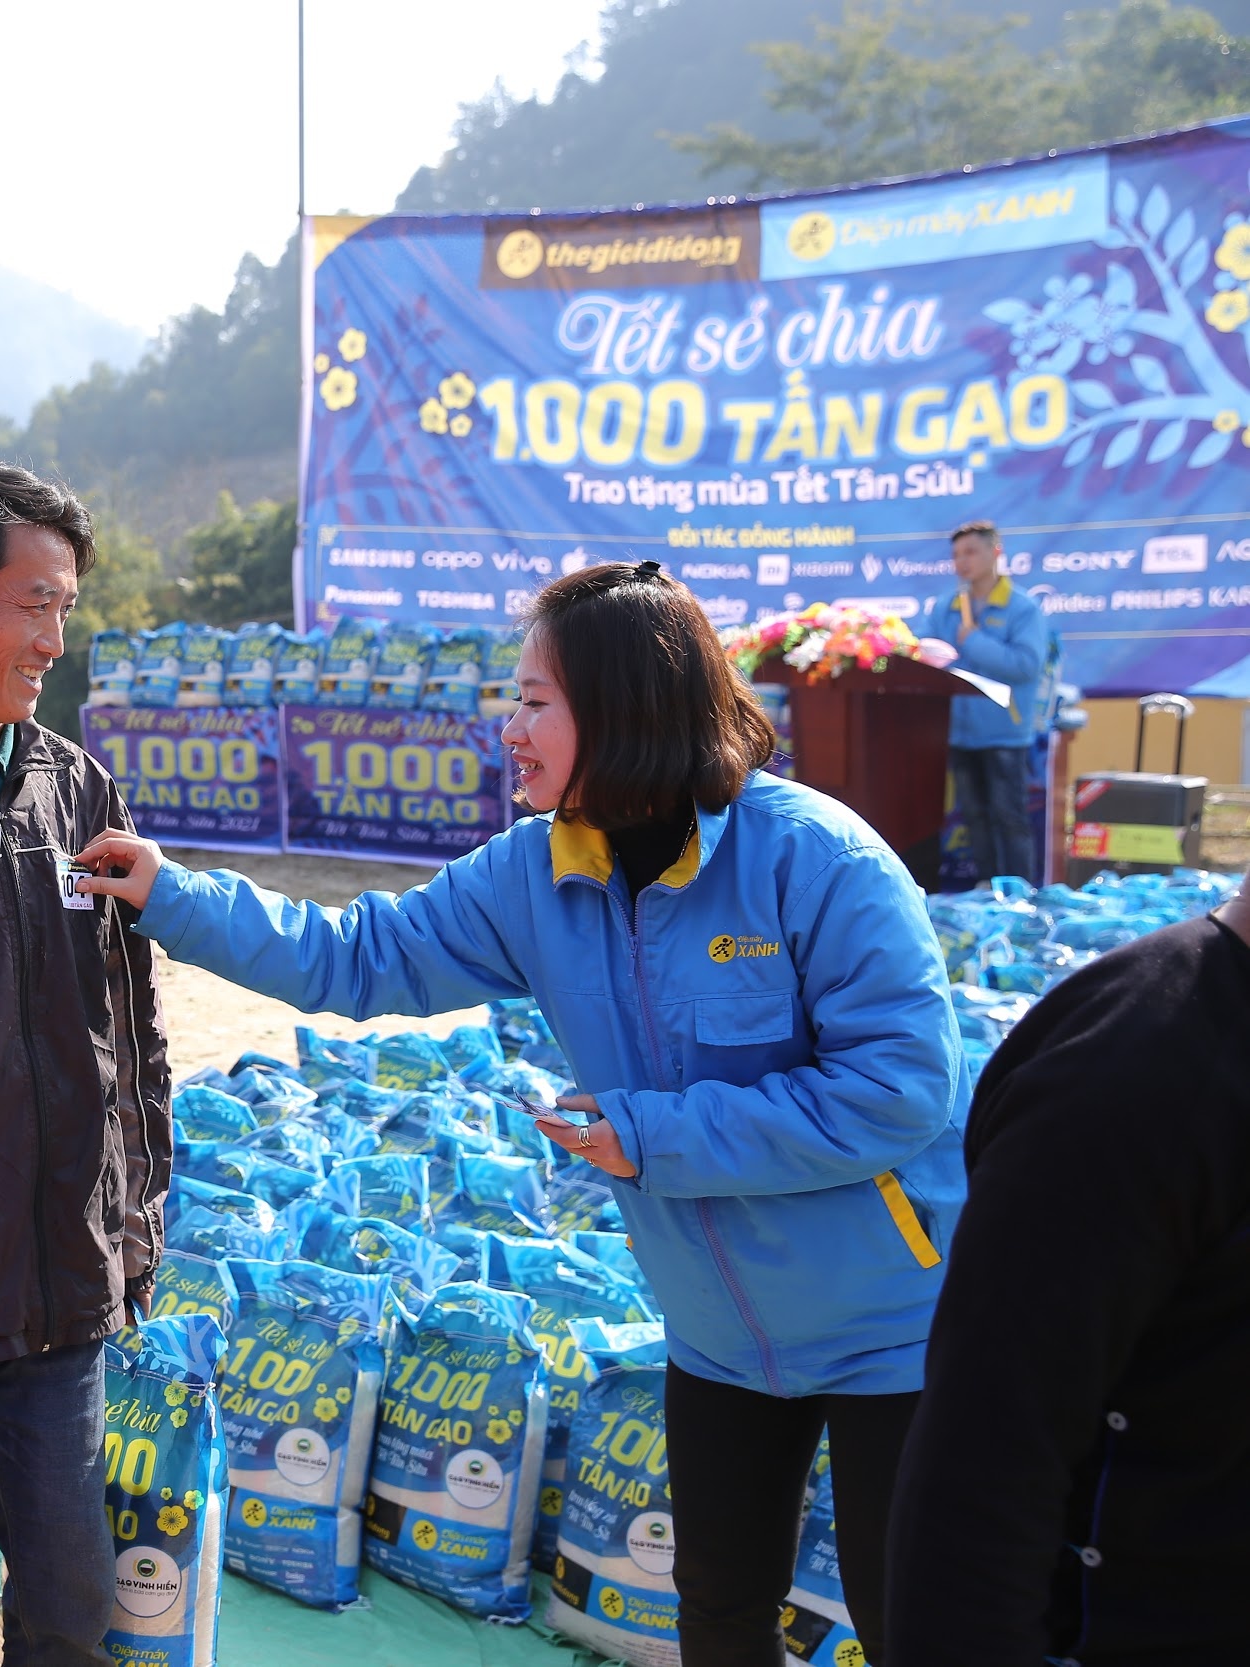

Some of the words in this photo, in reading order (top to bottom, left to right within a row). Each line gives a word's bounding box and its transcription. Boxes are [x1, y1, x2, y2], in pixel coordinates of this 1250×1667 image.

[971, 186, 1076, 224] XANH
[558, 292, 684, 376] Tết
[687, 298, 769, 373] sẻ
[776, 284, 943, 368] chia
[479, 377, 707, 466] 1.000
[723, 369, 882, 463] TẤN
[894, 373, 1068, 467] GẠO
[563, 473, 629, 504] Trao
[629, 474, 694, 513] tặng
[696, 471, 768, 506] mùa
[771, 463, 829, 505] Tết
[831, 467, 900, 501] Tân
[903, 463, 974, 497] Sửu
[1041, 549, 1137, 573] SONY
[1110, 587, 1204, 611] PHILIPS
[101, 736, 259, 783] 1.000
[303, 741, 481, 795] 1.000
[188, 786, 261, 815] GẠO
[401, 796, 481, 828] GẠO
[736, 942, 780, 958] XANH
[382, 1394, 428, 1434] TẤN
[268, 1515, 317, 1531] XANH
[437, 1540, 489, 1560] XANH
[132, 1581, 155, 1590] VINH
[625, 1607, 678, 1630] XANH
[111, 1643, 139, 1659] Điện
[139, 1648, 169, 1660] máy
